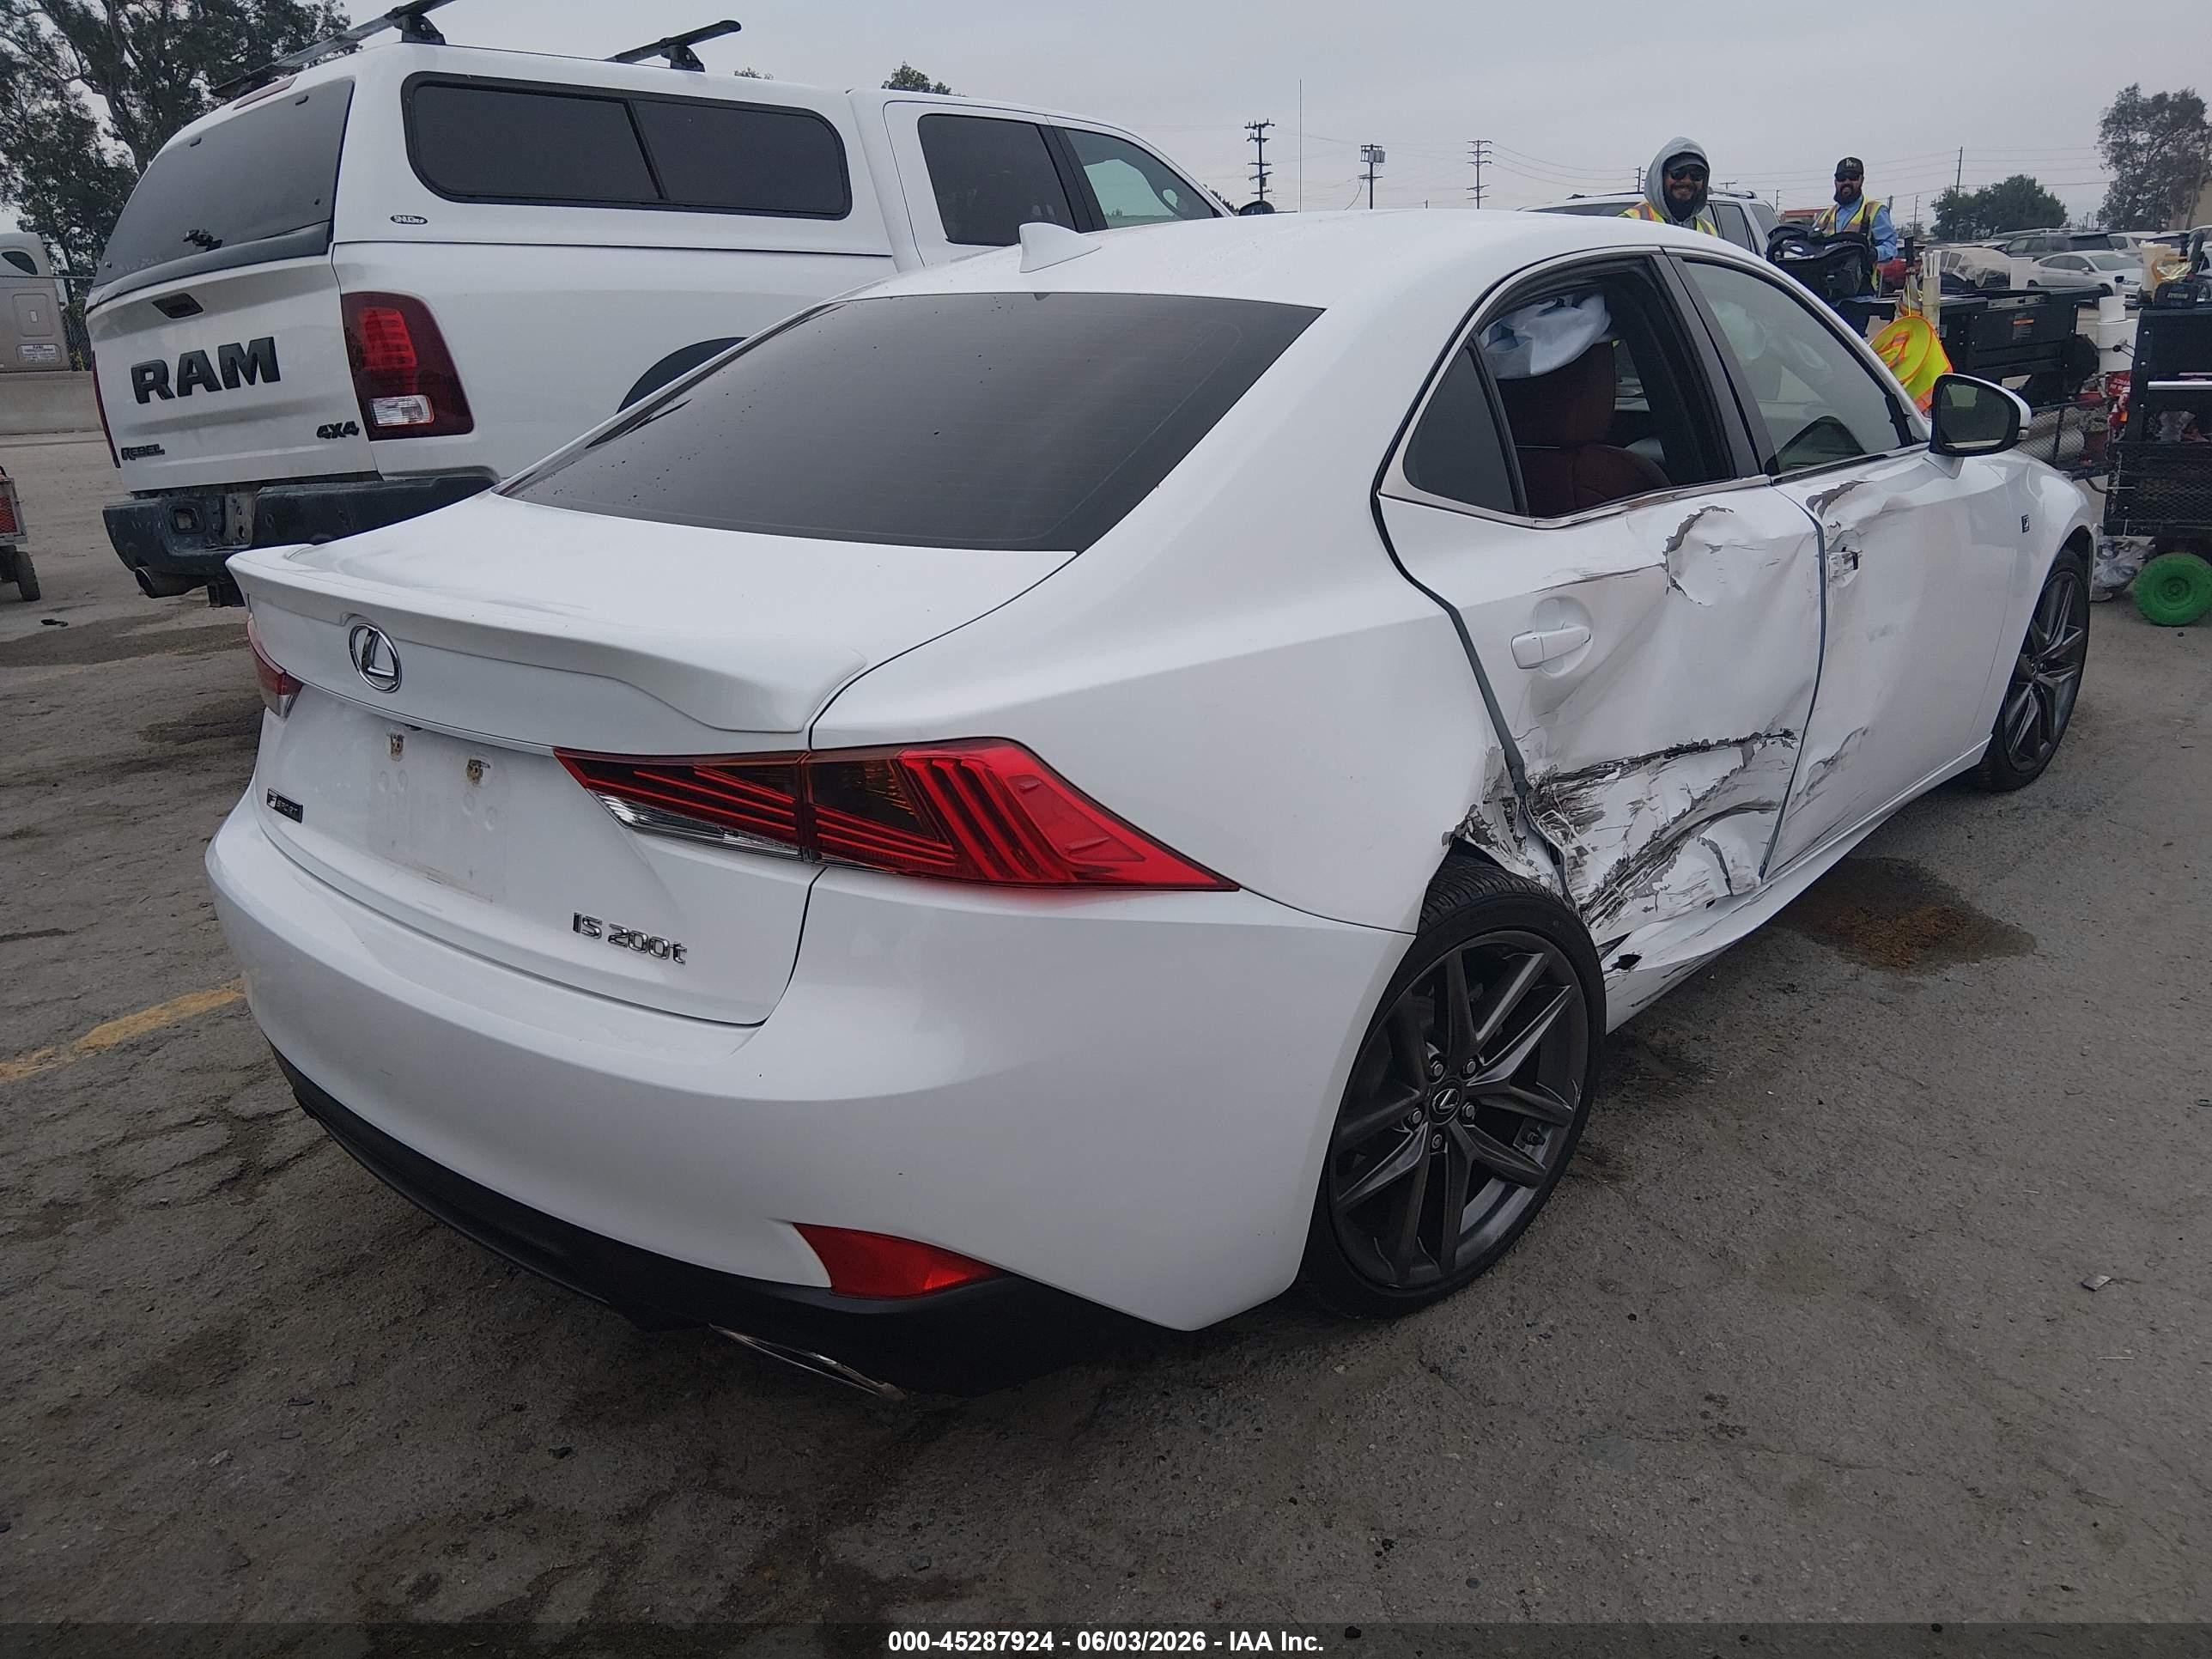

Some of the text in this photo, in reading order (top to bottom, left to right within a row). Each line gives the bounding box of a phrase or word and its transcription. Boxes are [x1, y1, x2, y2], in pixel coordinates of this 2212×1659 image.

[131, 336, 280, 404] RAM
[316, 421, 360, 439] 4X4
[120, 443, 166, 461] REBEL
[572, 911, 688, 965] IS 200t
